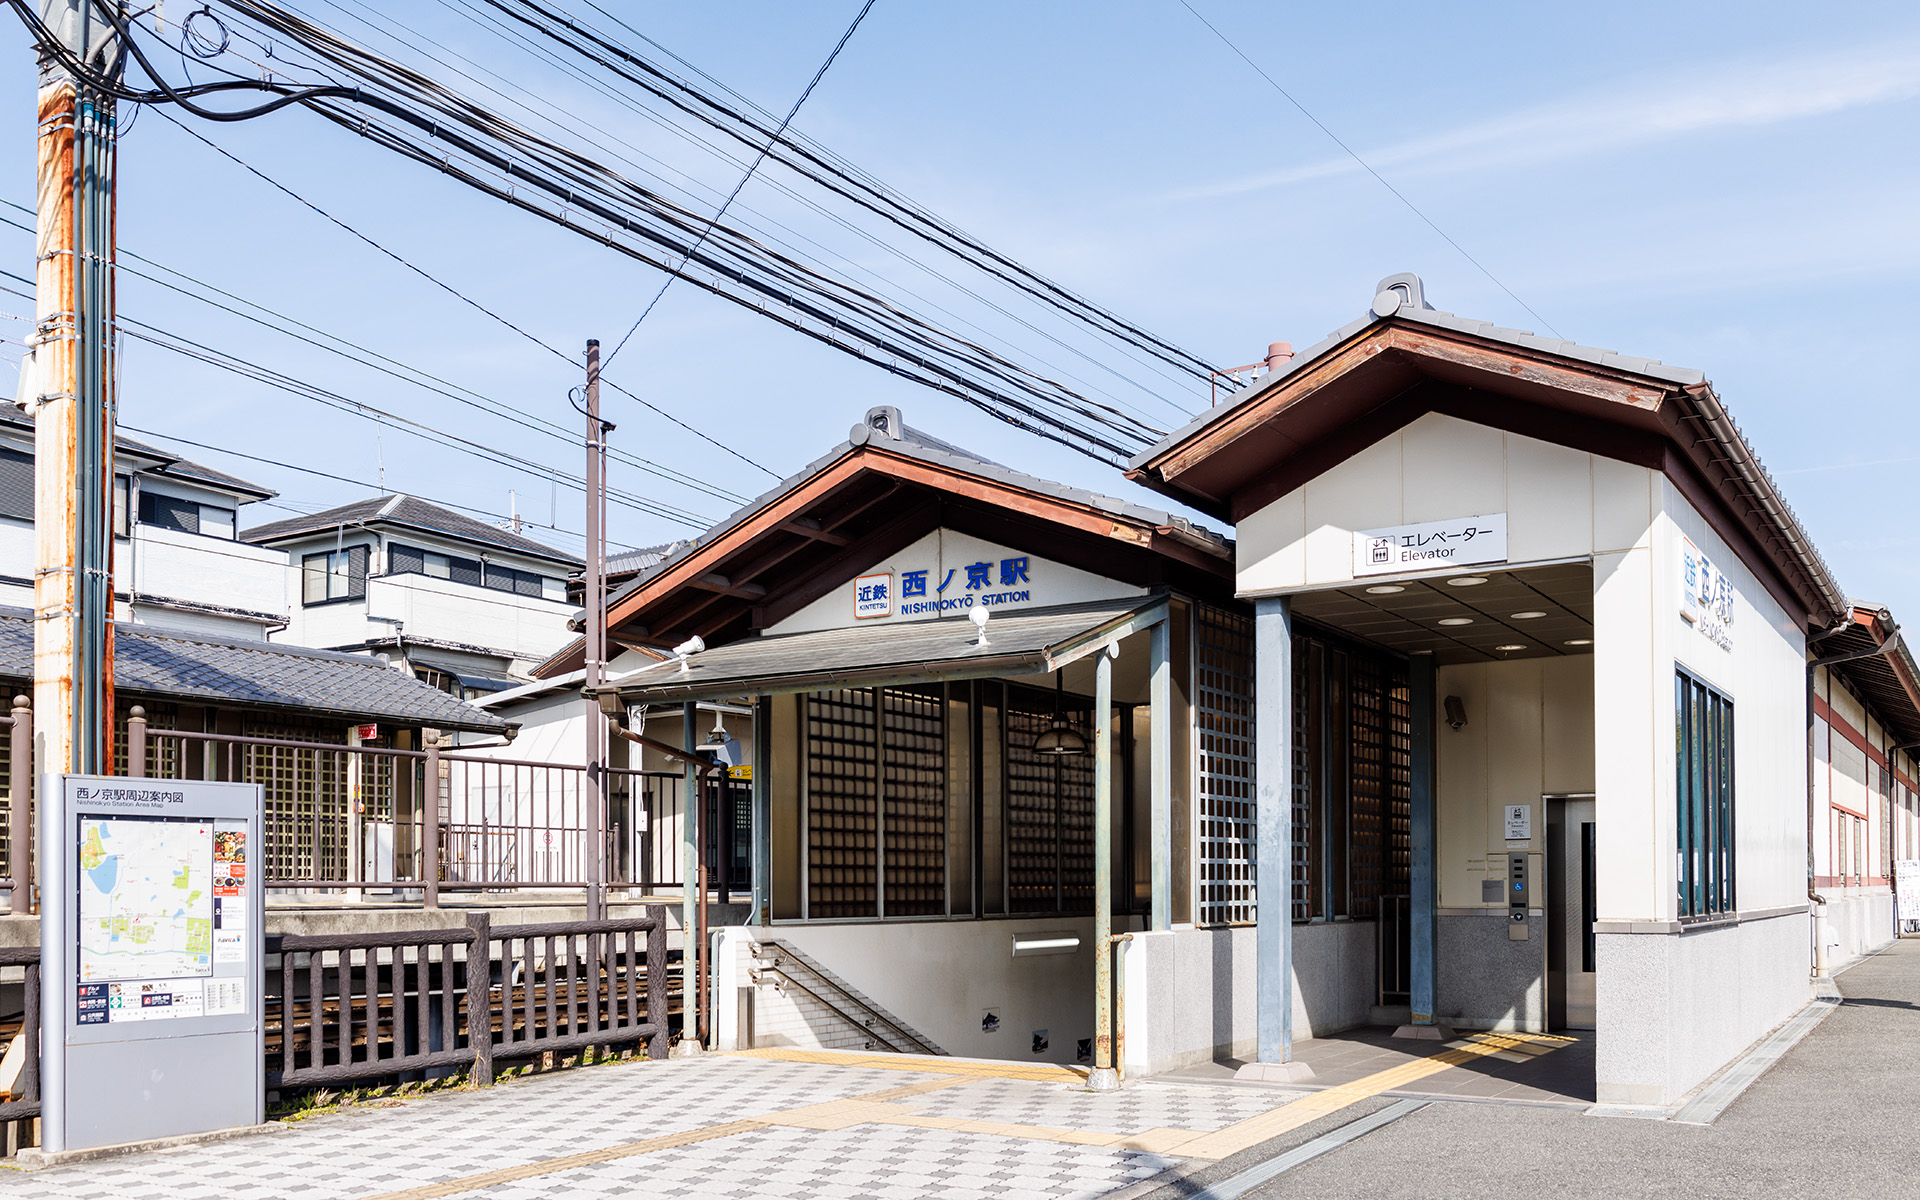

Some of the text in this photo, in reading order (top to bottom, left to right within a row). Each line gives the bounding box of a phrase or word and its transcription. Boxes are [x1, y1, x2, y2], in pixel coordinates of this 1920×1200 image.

[1401, 527, 1493, 548] エレベーター
[1401, 547, 1456, 562] Elevator
[901, 556, 1030, 598] 西ノ京駅
[858, 584, 888, 602] 近鉄
[981, 590, 1030, 606] STATION
[859, 602, 888, 611] KINTETSU
[76, 787, 184, 803] 西ノ京駅周辺案内図
[76, 799, 111, 807] Nishinokyo
